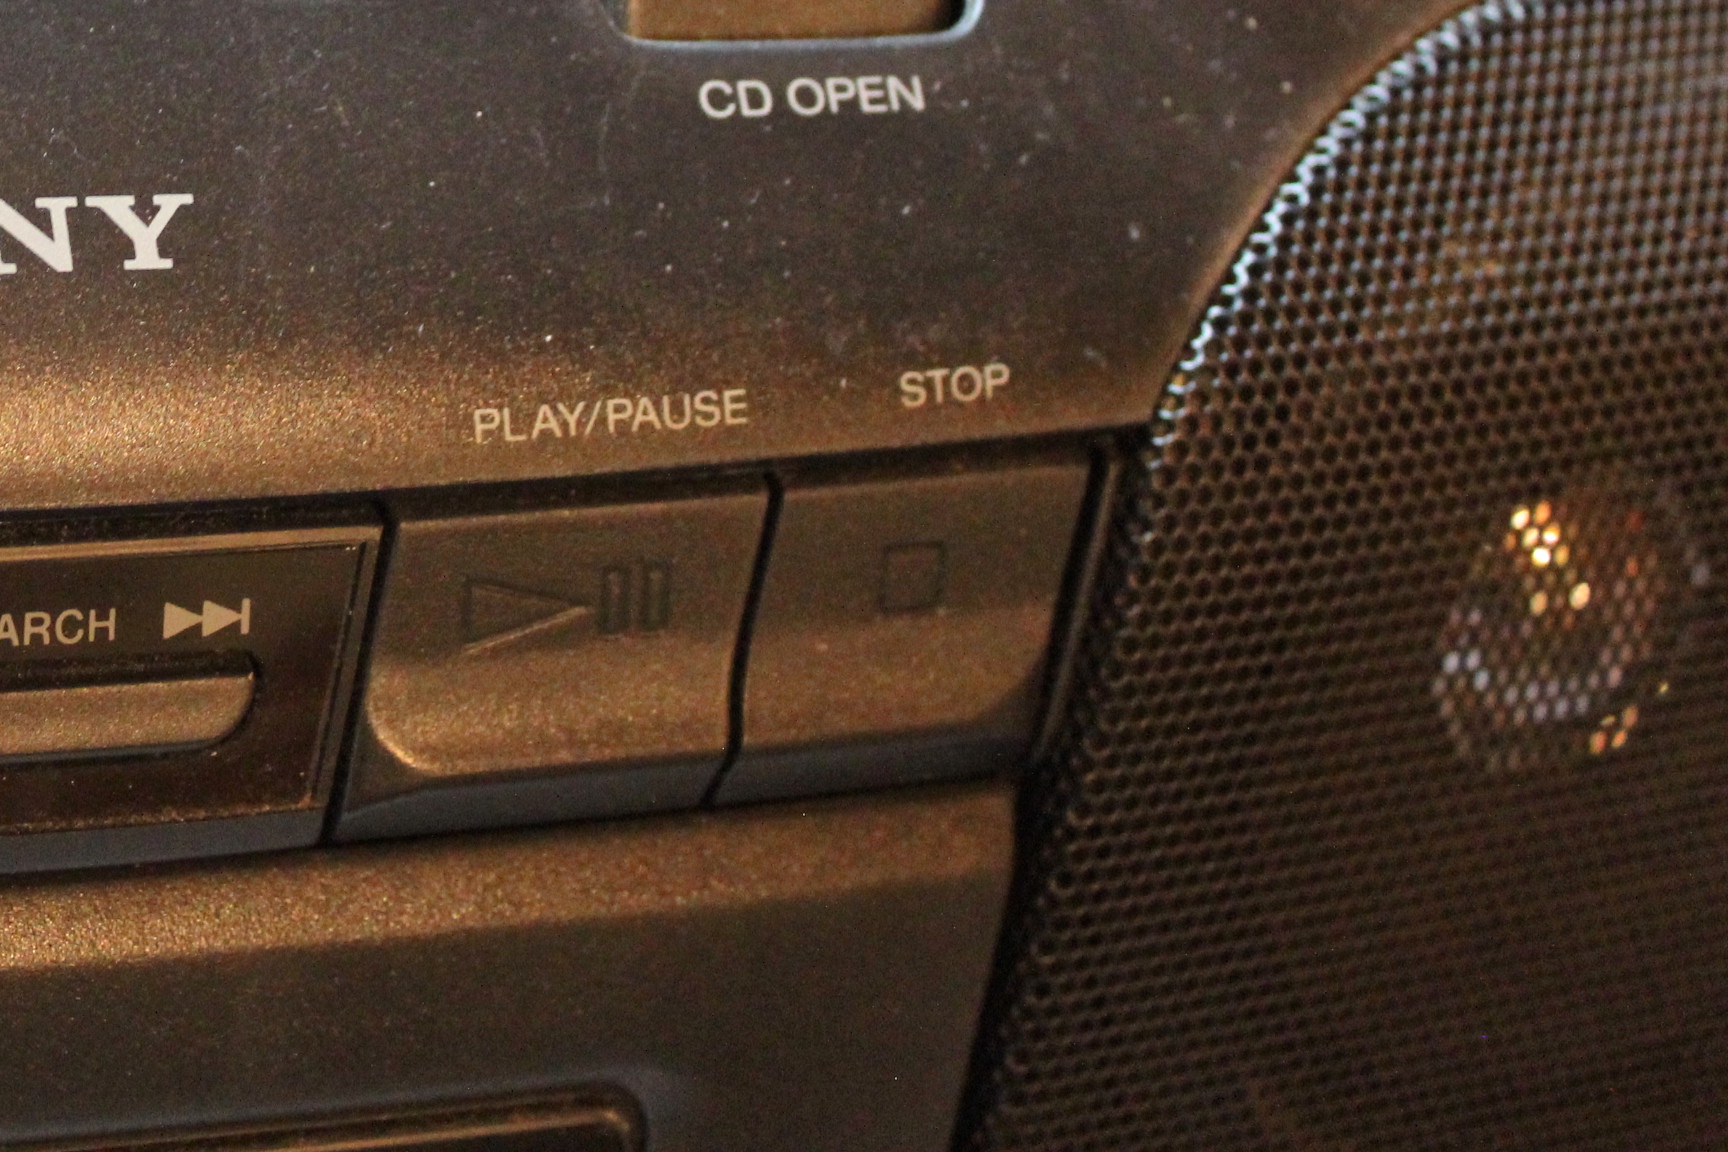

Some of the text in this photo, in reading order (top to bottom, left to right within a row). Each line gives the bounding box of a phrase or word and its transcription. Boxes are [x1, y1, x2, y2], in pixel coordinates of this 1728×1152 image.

[698, 74, 927, 120] CD OPEN
[899, 363, 1011, 408] STOP
[473, 389, 749, 444] PLAY/PAUSE
